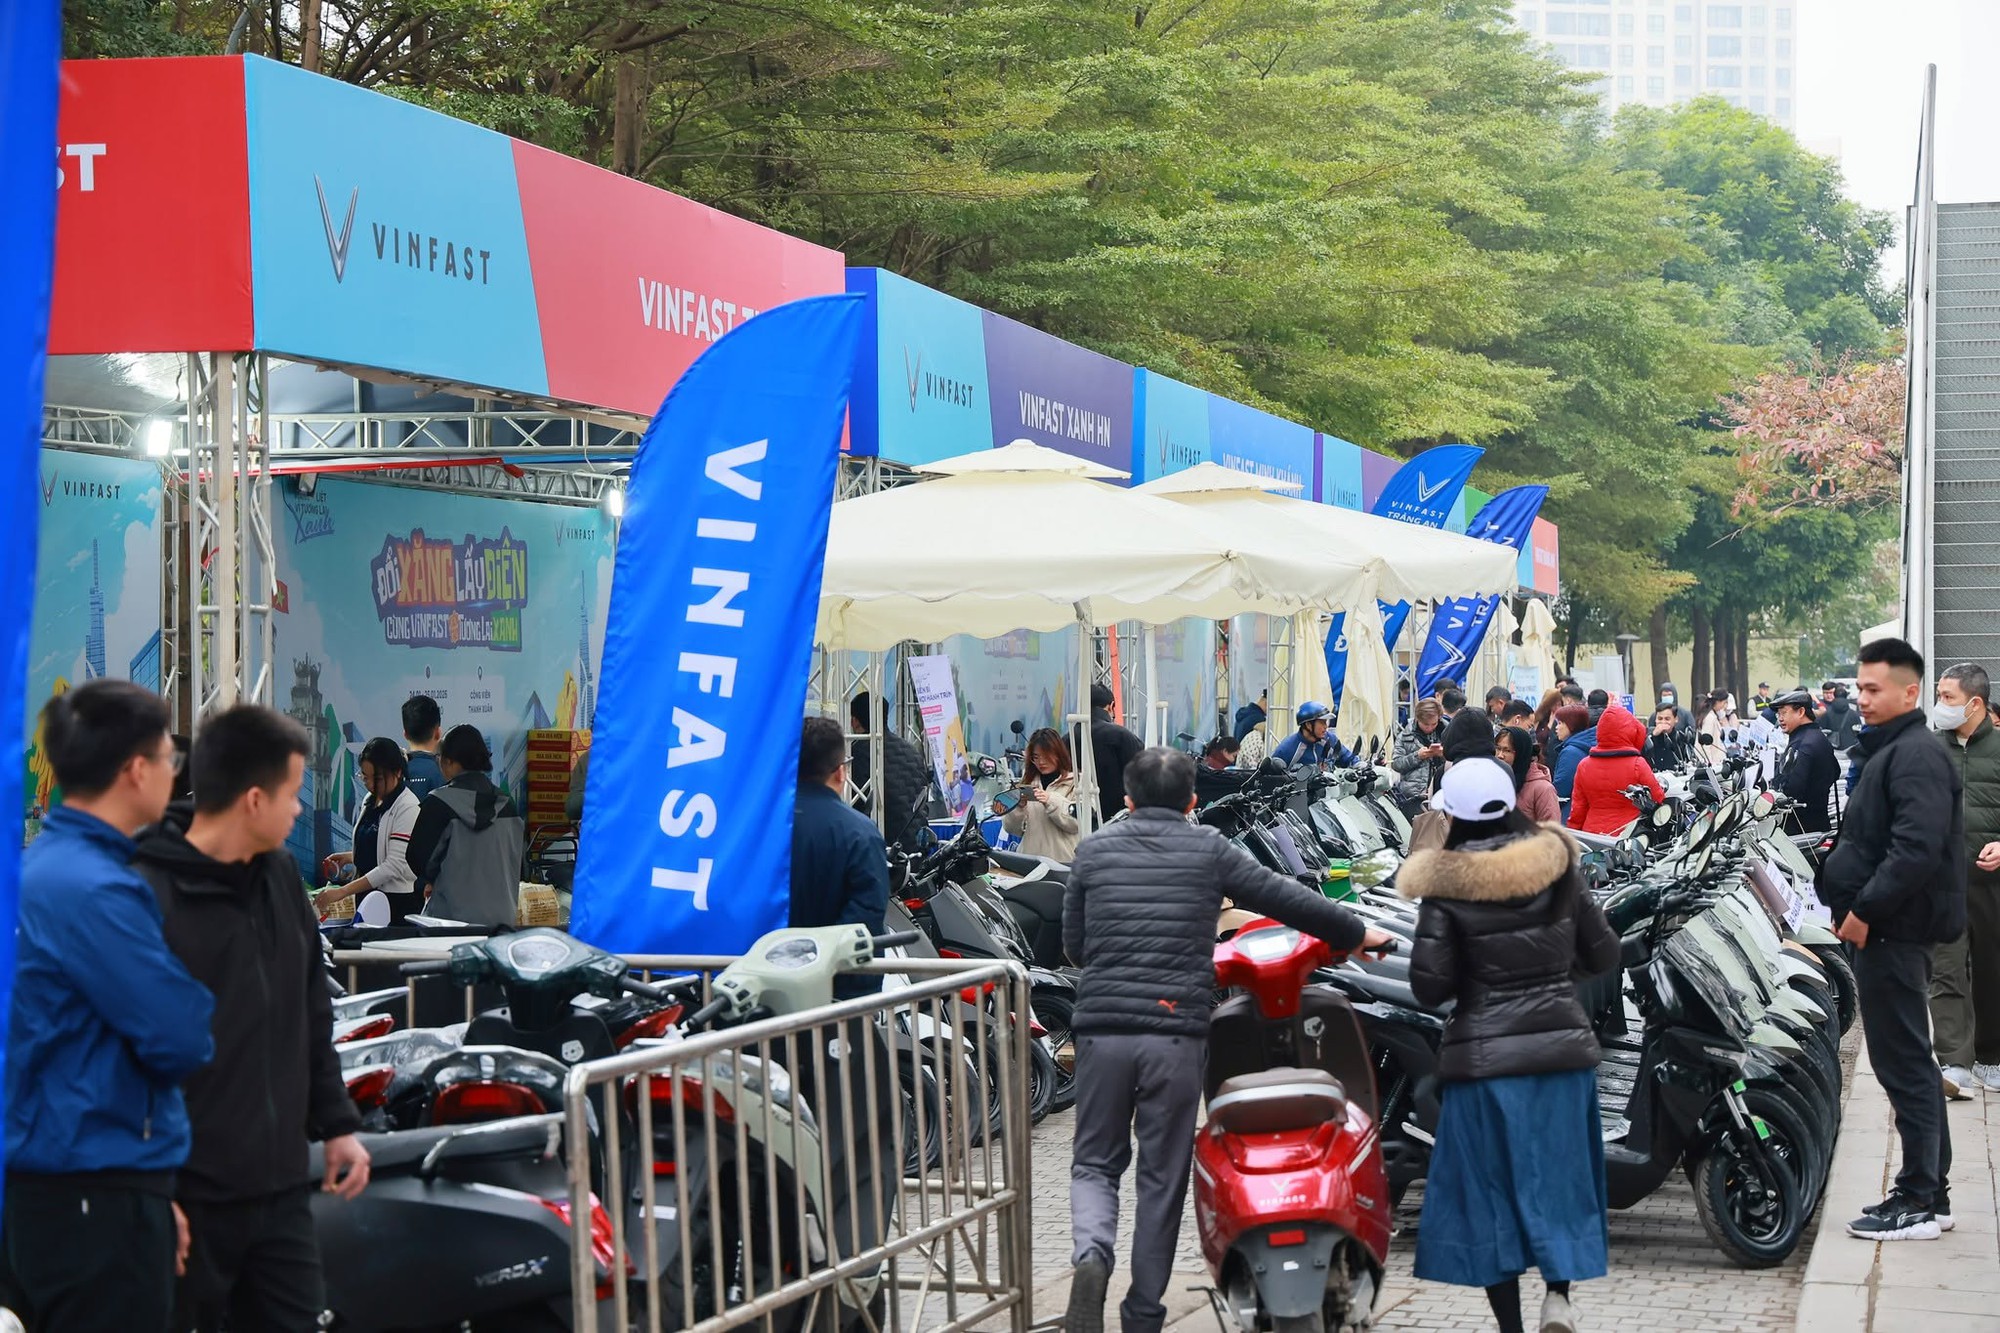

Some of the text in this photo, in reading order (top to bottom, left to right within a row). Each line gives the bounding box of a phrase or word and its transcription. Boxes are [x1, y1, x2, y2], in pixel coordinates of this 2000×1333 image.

[372, 222, 490, 285] VINFAST
[638, 276, 736, 343] VINFAST
[926, 371, 974, 409] VINFAST
[1019, 389, 1111, 448] VINFAST XANH HN
[1171, 443, 1201, 466] VINFAST
[64, 480, 121, 500] VINFAST
[1391, 500, 1445, 519] VINFAST
[566, 528, 595, 541] VINFAST
[386, 614, 411, 640] CÙNG
[410, 613, 449, 639] VINFAST
[650, 438, 768, 912] VINFAST
